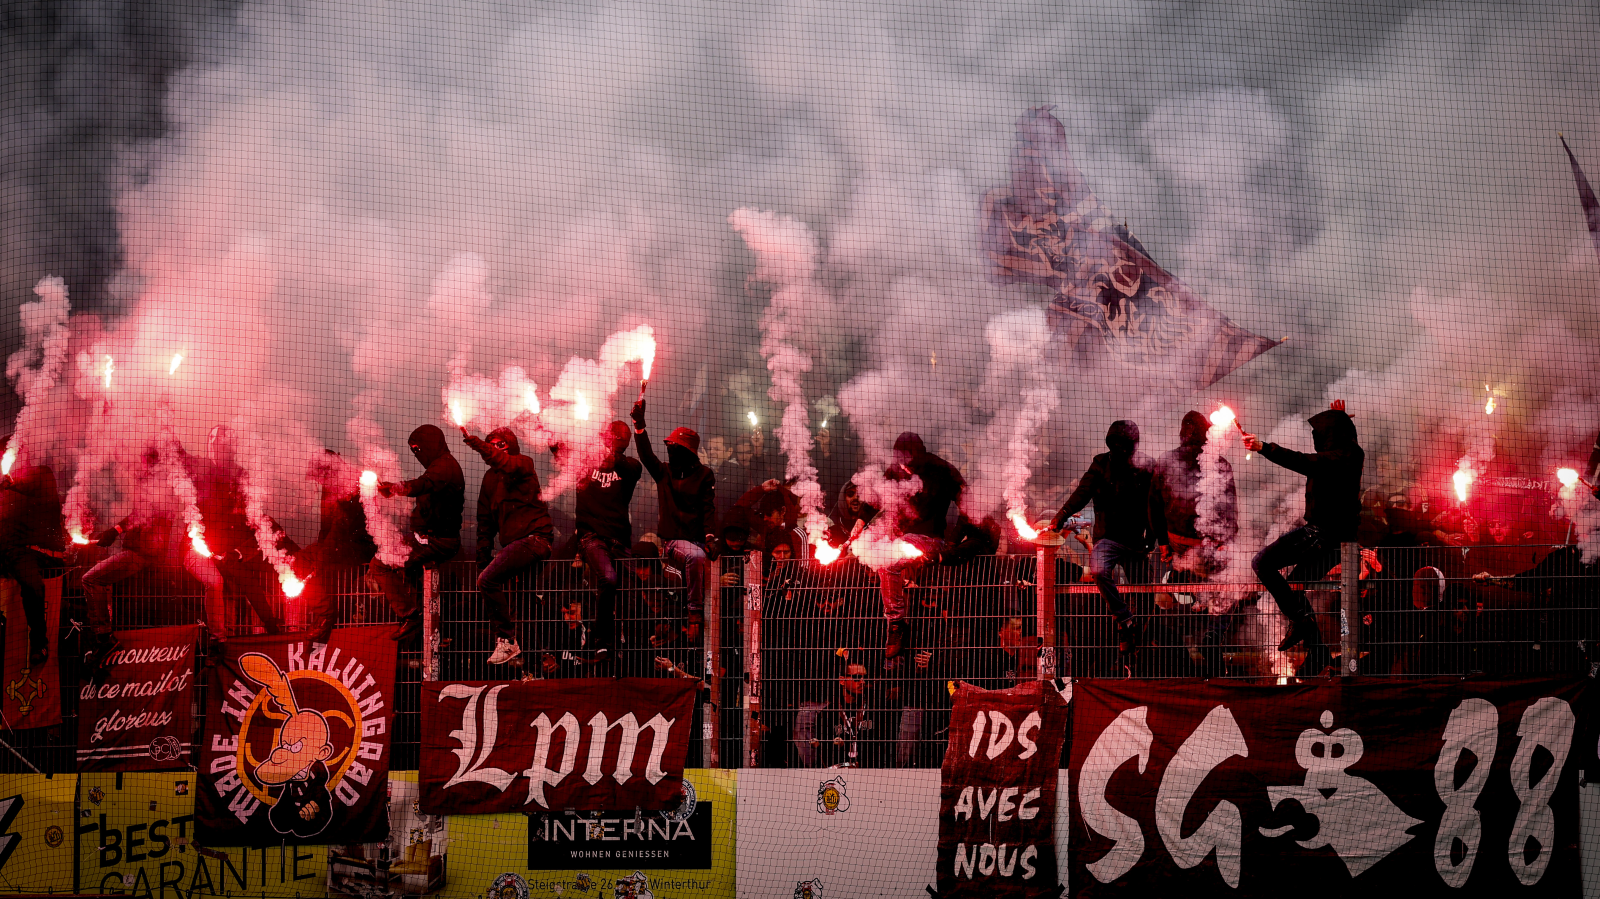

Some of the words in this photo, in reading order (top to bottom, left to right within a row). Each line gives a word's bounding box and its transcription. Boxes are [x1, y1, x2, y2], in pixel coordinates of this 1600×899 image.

[98, 683, 120, 699] ce
[121, 668, 193, 697] mailot
[220, 679, 257, 723] IN
[287, 641, 387, 807] KALUINGRAD
[437, 683, 676, 810] Lpm
[968, 709, 1042, 761] IDS
[209, 733, 262, 825] MADE
[1077, 704, 1249, 889] SG
[1433, 696, 1576, 889] 88
[953, 786, 1041, 823] AVEC
[99, 814, 195, 868] BEST
[543, 818, 696, 842] INTERNA
[570, 850, 611, 858] WOHNEN
[615, 850, 670, 858] GENIESSEN
[99, 846, 317, 899] GARANTIE
[650, 878, 711, 890] Winterthur
[953, 842, 1039, 881] NOUS
